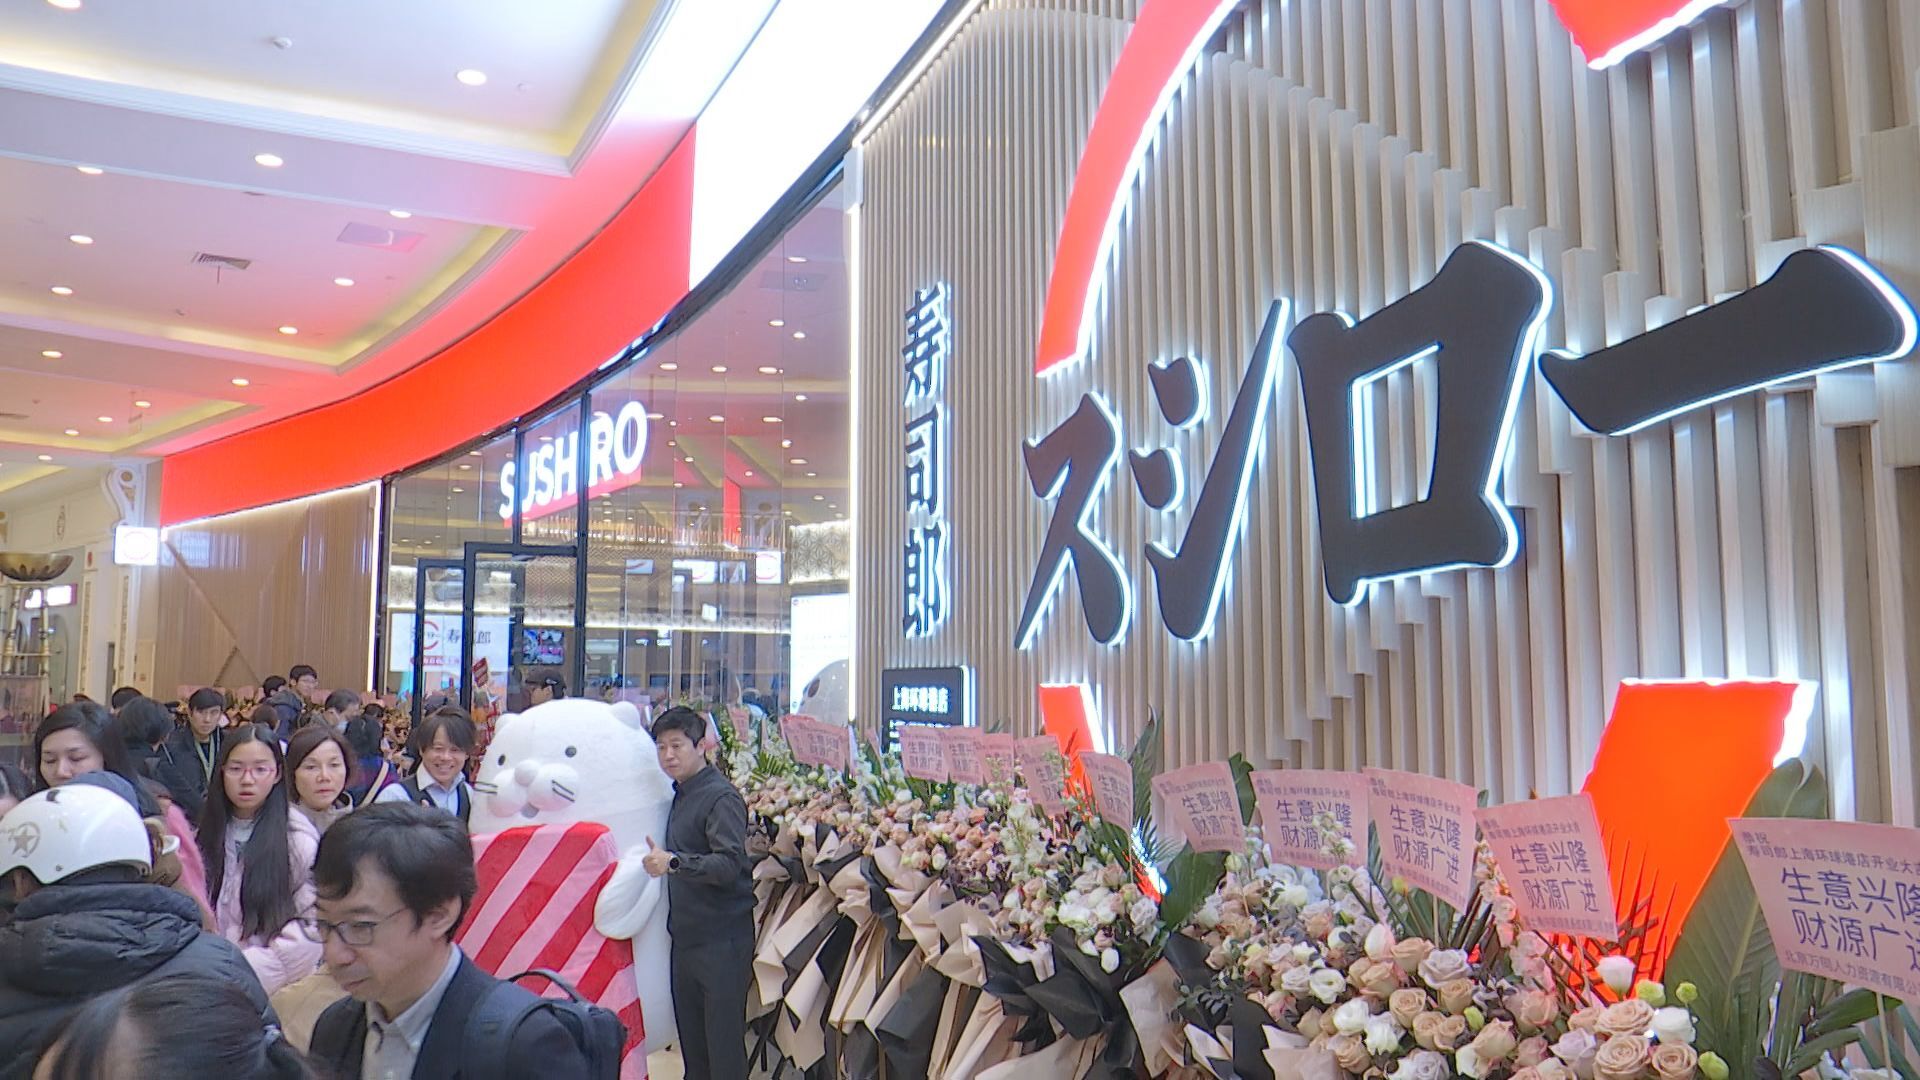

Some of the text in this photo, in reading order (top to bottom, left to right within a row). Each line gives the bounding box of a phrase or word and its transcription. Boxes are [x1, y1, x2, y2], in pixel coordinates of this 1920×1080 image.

[499, 400, 648, 519] SUSHRO
[901, 281, 949, 639] 寿司郎
[1015, 240, 1918, 649] スシロー
[1389, 803, 1461, 852] 生意兴隆
[1393, 834, 1461, 884] 财源广进
[1510, 839, 1591, 874] 生意兴隆
[1522, 878, 1599, 912] 财源广进
